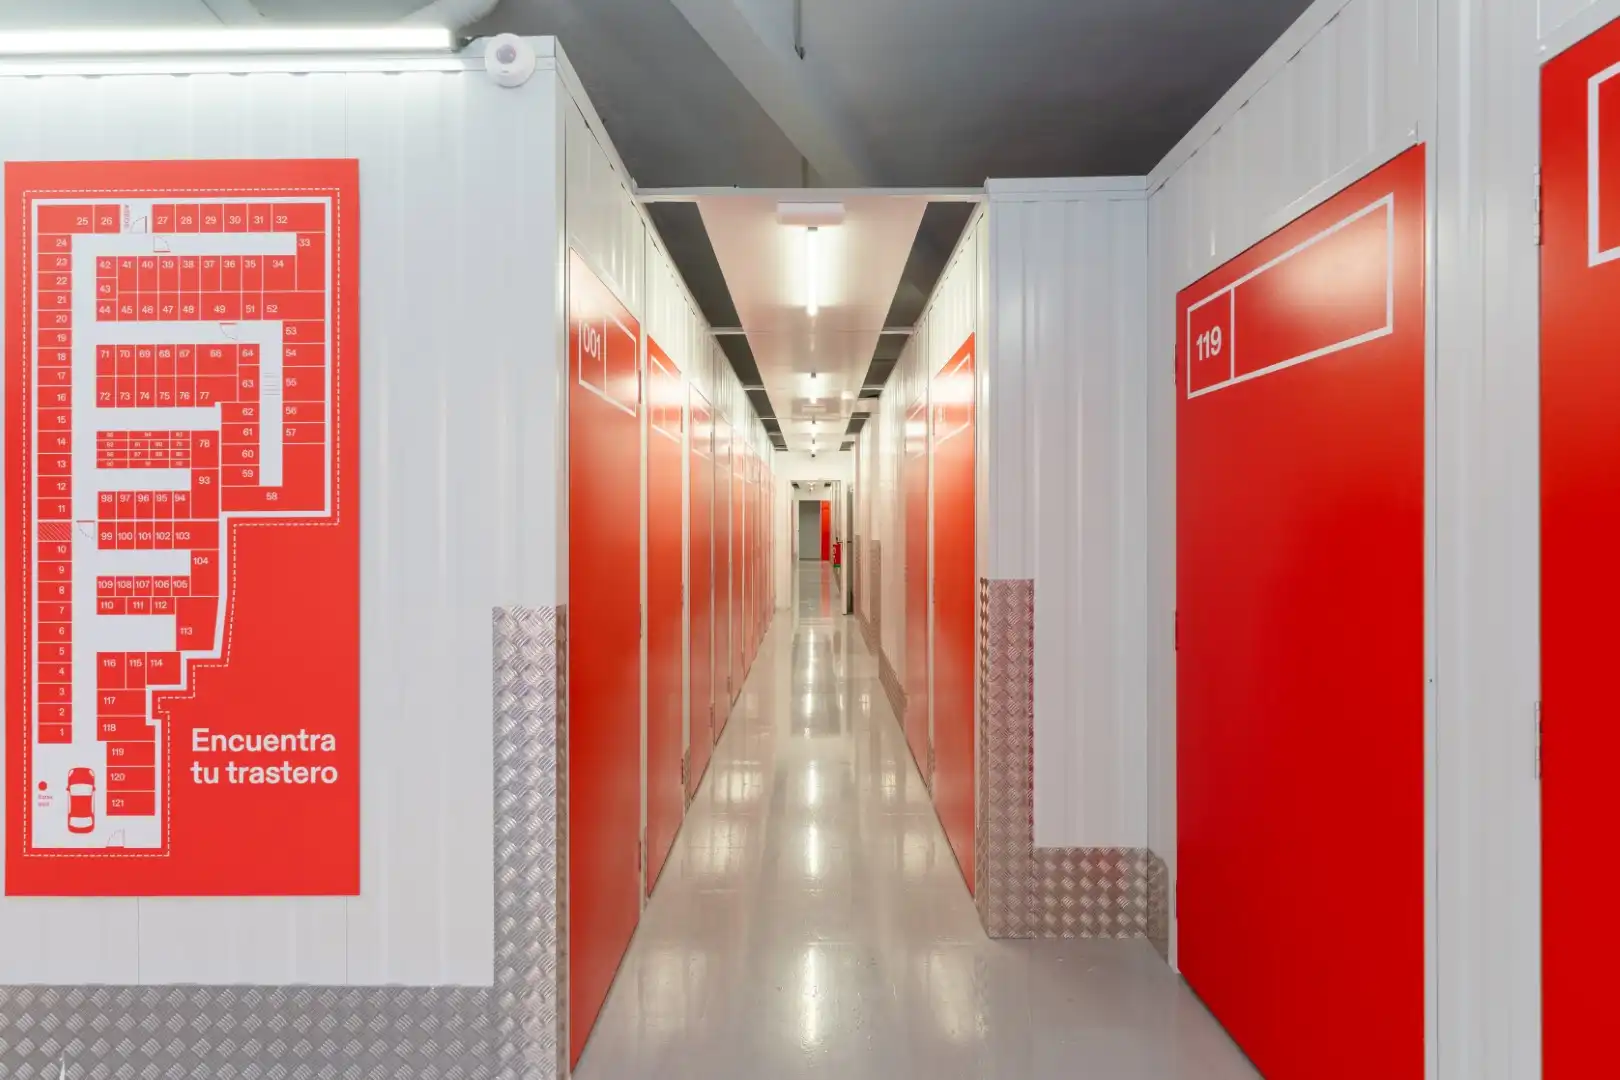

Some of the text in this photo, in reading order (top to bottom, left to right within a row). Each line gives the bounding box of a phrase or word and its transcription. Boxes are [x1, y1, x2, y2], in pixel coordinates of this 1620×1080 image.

[77, 217, 88, 225] 25
[101, 217, 112, 225] 26
[157, 216, 168, 225] 27
[180, 216, 192, 225] 28
[205, 216, 217, 224] 29
[229, 215, 241, 224] 30
[254, 215, 263, 224] 31
[276, 216, 288, 224] 32
[56, 238, 67, 247] 24
[99, 261, 111, 269] 42
[162, 260, 174, 268] 39
[182, 260, 194, 268] 38
[204, 260, 216, 269] 37
[224, 260, 235, 268] 36
[273, 260, 284, 268] 34
[56, 276, 68, 285] 22
[100, 285, 111, 293] 43
[57, 296, 66, 304] 21
[99, 305, 111, 314] 44
[121, 305, 133, 314] 45
[162, 305, 174, 313] 47
[182, 305, 194, 313] 48
[214, 305, 226, 313] 49
[246, 304, 255, 313] 51
[266, 305, 278, 313] 52
[56, 314, 67, 323] 20
[285, 326, 297, 335] 53
[57, 334, 67, 342] 19
[583, 322, 601, 361] 001
[1196, 325, 1222, 361] 119
[57, 352, 66, 361] 18
[101, 350, 110, 358] 71
[120, 350, 130, 358] 70
[285, 348, 296, 357] 54
[57, 371, 66, 380] 17
[242, 379, 254, 388] 63
[57, 393, 66, 401] 16
[100, 392, 111, 400] 72
[120, 392, 131, 400] 73
[140, 392, 150, 400] 74
[159, 391, 170, 400] 75
[179, 391, 190, 400] 76
[200, 391, 210, 399] 77
[242, 408, 254, 416] 62
[285, 406, 297, 415] 56
[57, 416, 66, 424] 15
[243, 428, 252, 436] 61
[286, 428, 296, 437] 57
[200, 439, 210, 448] 78
[242, 449, 254, 458] 60
[57, 460, 66, 468] 13
[242, 469, 254, 478] 59
[198, 476, 210, 485] 93
[57, 482, 66, 491] 12
[101, 494, 113, 502] 98
[120, 494, 131, 502] 97
[138, 494, 149, 502] 96
[156, 494, 167, 502] 95
[174, 494, 186, 502] 94
[266, 492, 278, 501] 58
[100, 532, 113, 540] 99
[117, 532, 133, 540] 100
[138, 532, 151, 540] 101
[155, 532, 171, 540] 102
[175, 531, 190, 540] 103
[57, 545, 67, 554] 10
[193, 557, 209, 565] 104
[58, 566, 65, 574] 9
[98, 580, 113, 589] 109
[117, 580, 132, 589] 108
[136, 580, 150, 588] 107
[154, 580, 170, 588] 106
[59, 586, 65, 594] 8
[101, 601, 114, 609] 110
[133, 601, 144, 609] 111
[155, 601, 167, 609] 112
[60, 606, 64, 614] 7
[59, 627, 65, 635] 6
[180, 627, 193, 635] 113
[59, 647, 65, 655] 5
[103, 659, 116, 667] 116
[129, 658, 143, 667] 115
[59, 667, 65, 675] 4
[59, 687, 65, 696] 3
[104, 696, 116, 704] 117
[59, 708, 65, 716] 2
[60, 728, 64, 736] 1
[103, 724, 116, 732] 118
[192, 727, 336, 752] Encuentra
[112, 748, 124, 756] 119
[190, 761, 338, 784] tu trastero
[111, 773, 126, 781] 120
[112, 799, 124, 807] 121
